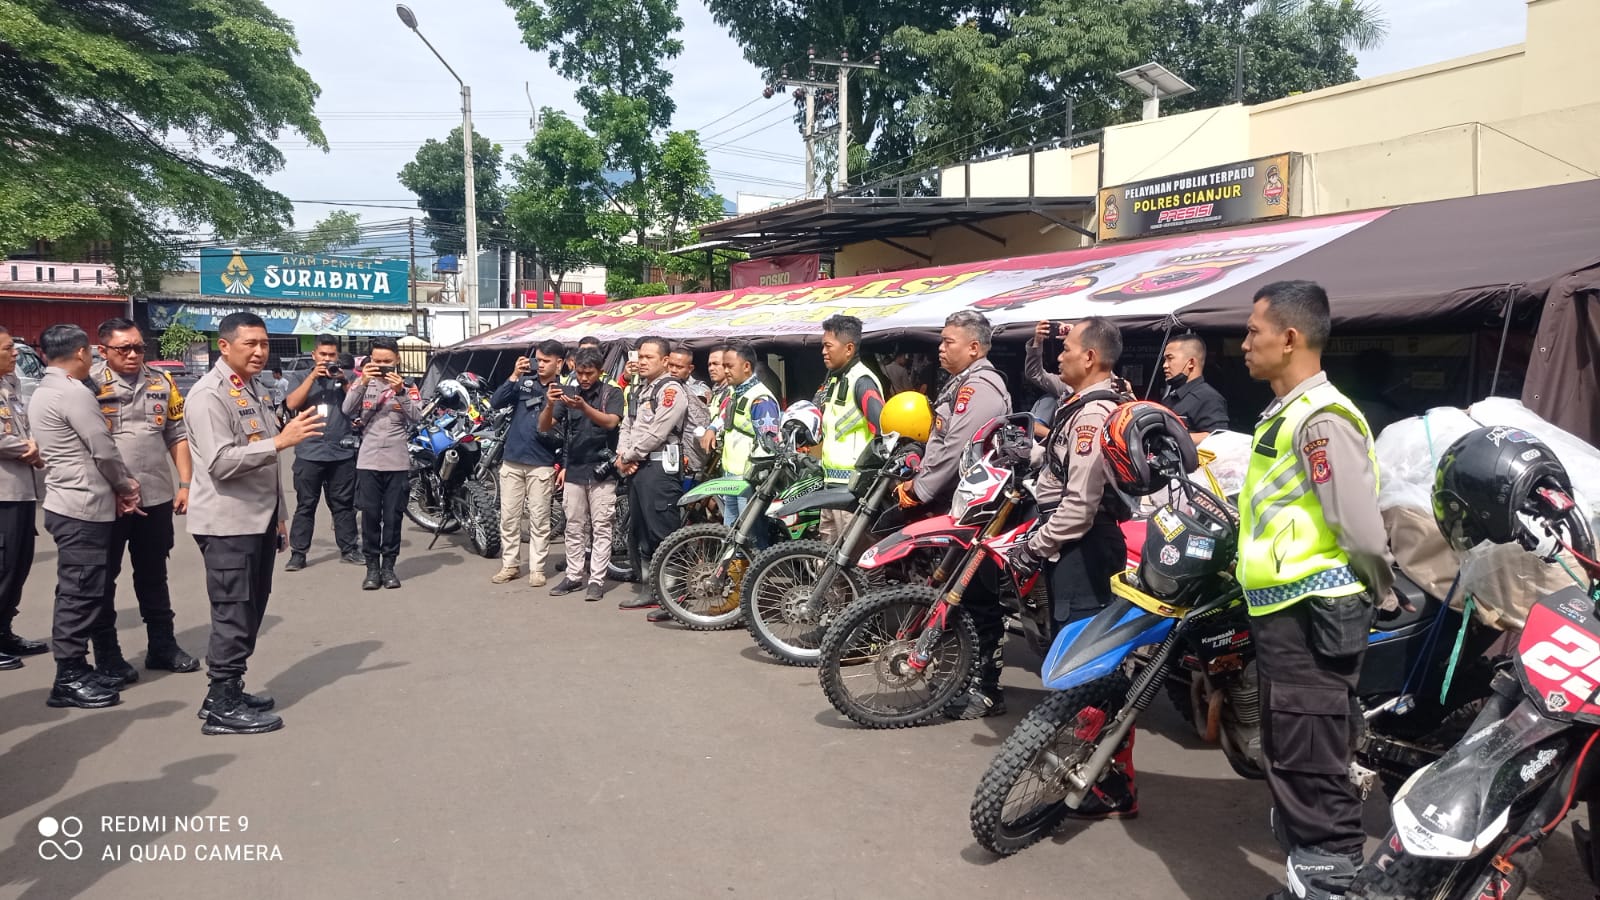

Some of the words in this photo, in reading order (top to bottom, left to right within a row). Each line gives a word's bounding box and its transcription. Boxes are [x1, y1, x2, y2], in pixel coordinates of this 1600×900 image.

[1125, 181, 1172, 199] PELAYANAN
[1173, 173, 1208, 192] PUBLIK
[1210, 166, 1255, 186] TERPADU
[1133, 193, 1180, 213] POLRES
[1183, 184, 1242, 204] CIANJUR
[1157, 203, 1214, 223] PRESISI
[282, 256, 316, 266] AYAM
[322, 259, 373, 270] PENYET
[264, 265, 391, 294] SURABAYA
[760, 272, 790, 286] POSKO
